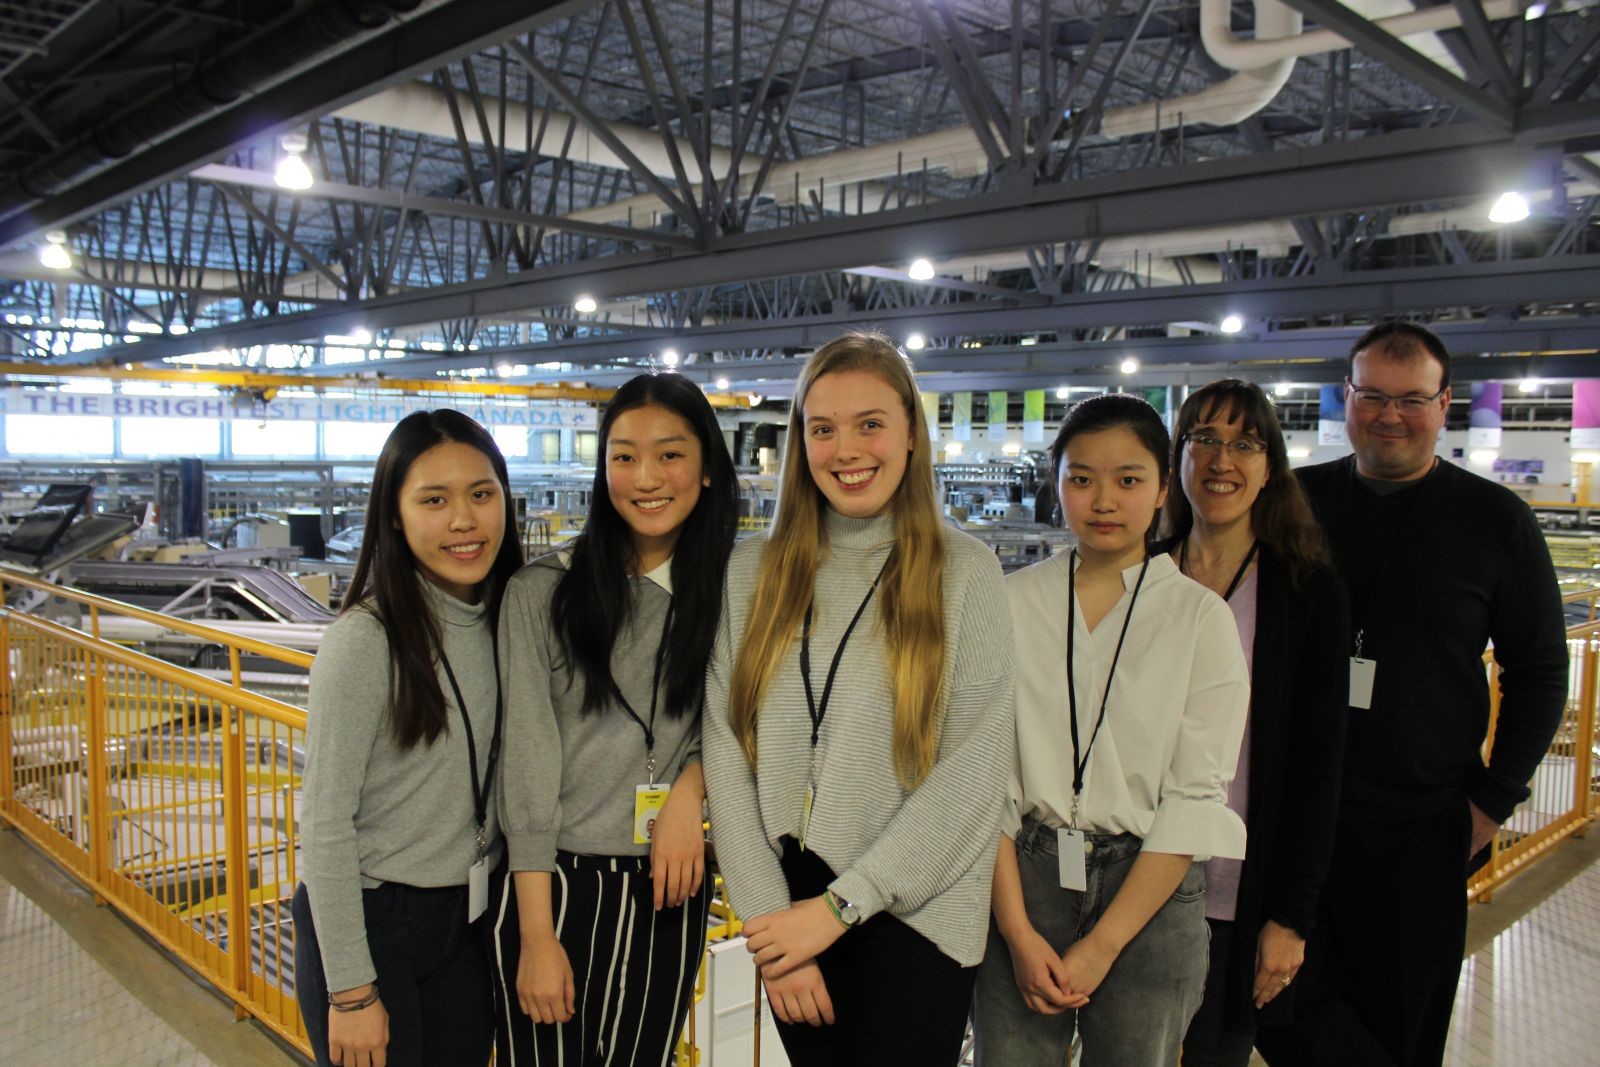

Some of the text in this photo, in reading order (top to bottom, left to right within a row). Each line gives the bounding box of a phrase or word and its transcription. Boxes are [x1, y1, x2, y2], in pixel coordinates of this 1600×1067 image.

[23, 394, 99, 414] THE
[317, 403, 405, 421] LIGHT
[456, 407, 564, 425] ANADA
